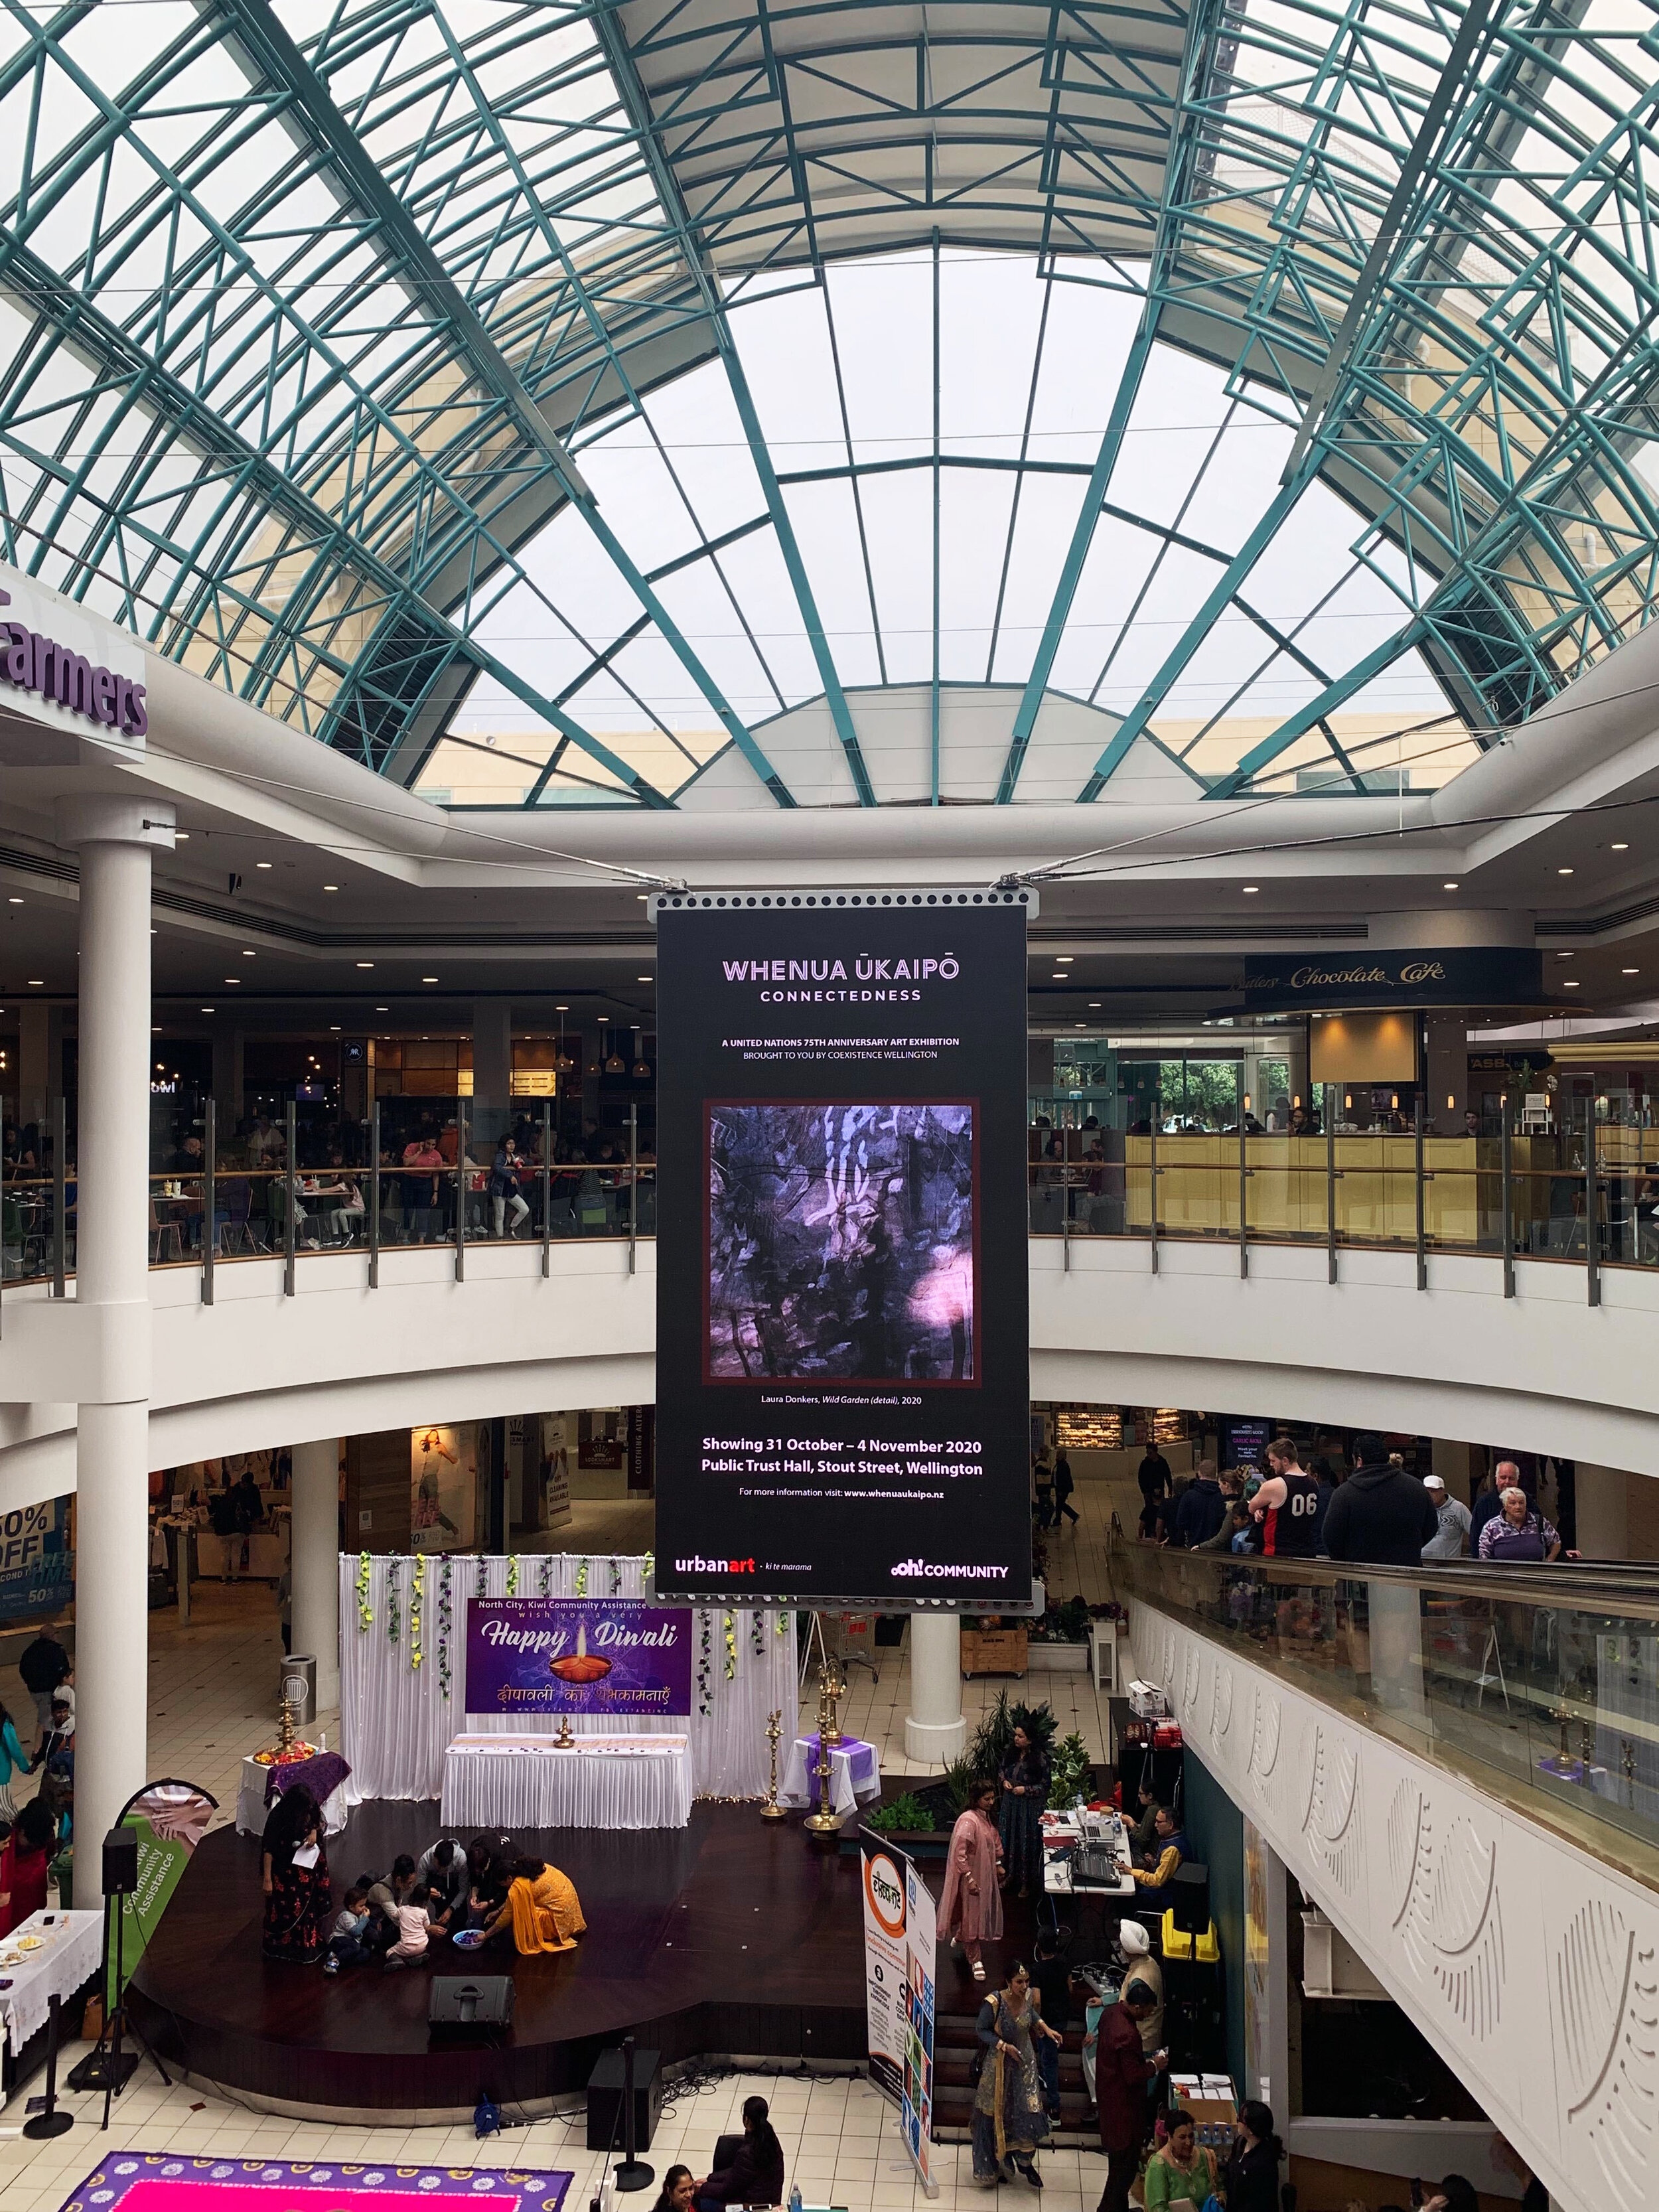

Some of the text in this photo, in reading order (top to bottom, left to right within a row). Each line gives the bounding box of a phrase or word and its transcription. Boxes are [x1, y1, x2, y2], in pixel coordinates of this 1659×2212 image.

[0, 589, 148, 736] armers
[723, 952, 960, 982] WHENUA ŪKAIPŌ
[1291, 967, 1386, 988] Chocolate
[1400, 962, 1446, 983] Café
[760, 990, 921, 1002] CONNECTEDNESS
[884, 1051, 938, 1059] WELLINGTON
[1471, 1059, 1505, 1069] ASB
[786, 1395, 820, 1404] Donkers,
[871, 1396, 900, 1405] (detail),
[902, 1396, 922, 1405] 2020
[703, 1438, 763, 1453] Showing
[766, 1438, 782, 1450] 31
[787, 1438, 844, 1451] October
[857, 1439, 867, 1451] 4
[870, 1439, 944, 1453] November
[946, 1441, 982, 1453] 2020
[702, 1459, 983, 1477] Public Trust Hall, Stout Street, Wellington
[776, 1488, 823, 1497] information
[844, 1490, 944, 1500] www.whenuaukaipo.nz
[1292, 1493, 1317, 1516] 06
[0, 1503, 47, 1538] 0%
[0, 1535, 39, 1568] FF
[675, 1555, 755, 1574] urbanart
[924, 1565, 1009, 1578] COMMUNITY
[506, 1601, 525, 1610] City,
[549, 1601, 599, 1611] Community
[481, 1620, 678, 1658] Happy Diwali
[497, 1684, 555, 1703] दीपावली
[123, 1848, 163, 1914] Community
[138, 1853, 175, 1917] Assistance
